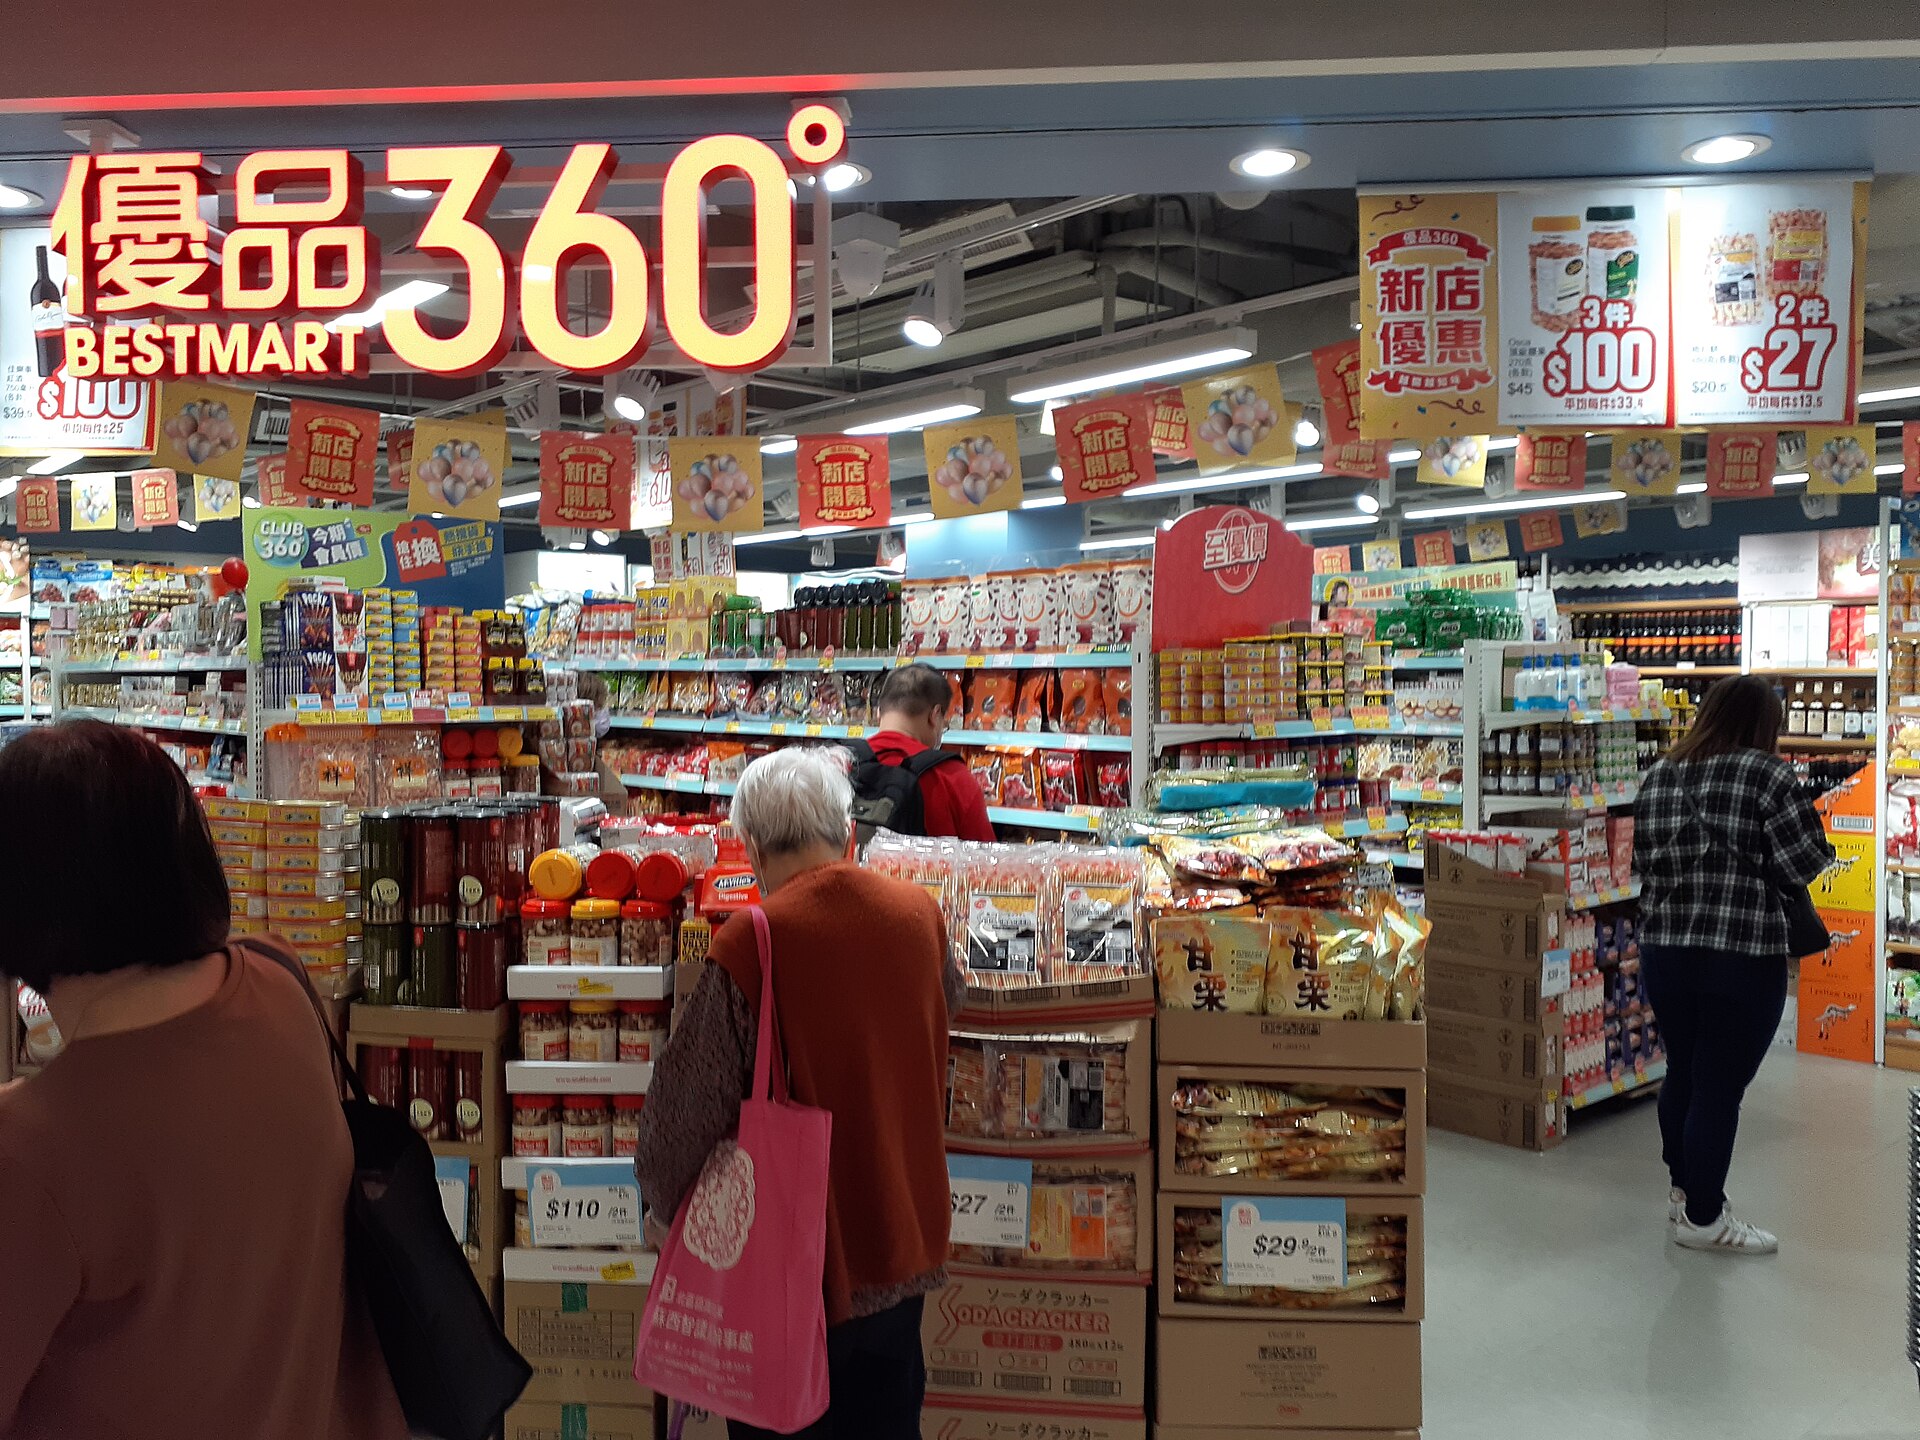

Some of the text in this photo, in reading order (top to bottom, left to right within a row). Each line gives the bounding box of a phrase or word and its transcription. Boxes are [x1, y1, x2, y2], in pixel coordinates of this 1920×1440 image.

[52, 149, 366, 313] 優品
[1379, 266, 1483, 314] 新店
[1583, 299, 1631, 330] 3件
[1777, 294, 1825, 326] 2件
[65, 321, 365, 379] BESTMART
[1379, 319, 1484, 367] 優惠
[1544, 328, 1656, 397] $100
[1743, 327, 1834, 391] $27
[1507, 381, 1534, 396] $45
[312, 432, 355, 458] 新店
[1081, 426, 1127, 456] 新店
[565, 461, 608, 485] 新店
[821, 460, 865, 484] 新店
[1084, 450, 1131, 479] 開幕
[564, 485, 608, 508] 開幕
[823, 484, 867, 508] 開幕
[259, 518, 305, 537] CLUB
[311, 523, 348, 546] 今期
[312, 540, 365, 567] 會員價
[1203, 522, 1269, 571] 至優價
[302, 592, 328, 606] POCKY
[307, 651, 333, 664] POCKY
[718, 875, 752, 889] McVitie's
[718, 891, 749, 902] Digestive
[1181, 935, 1228, 1012] 甘栗
[1288, 930, 1332, 1012] 甘栗
[546, 1198, 600, 1220] $110
[987, 1287, 1110, 1308] ソーダクラッカー
[986, 1420, 1110, 1440] ソーダクラッカー
